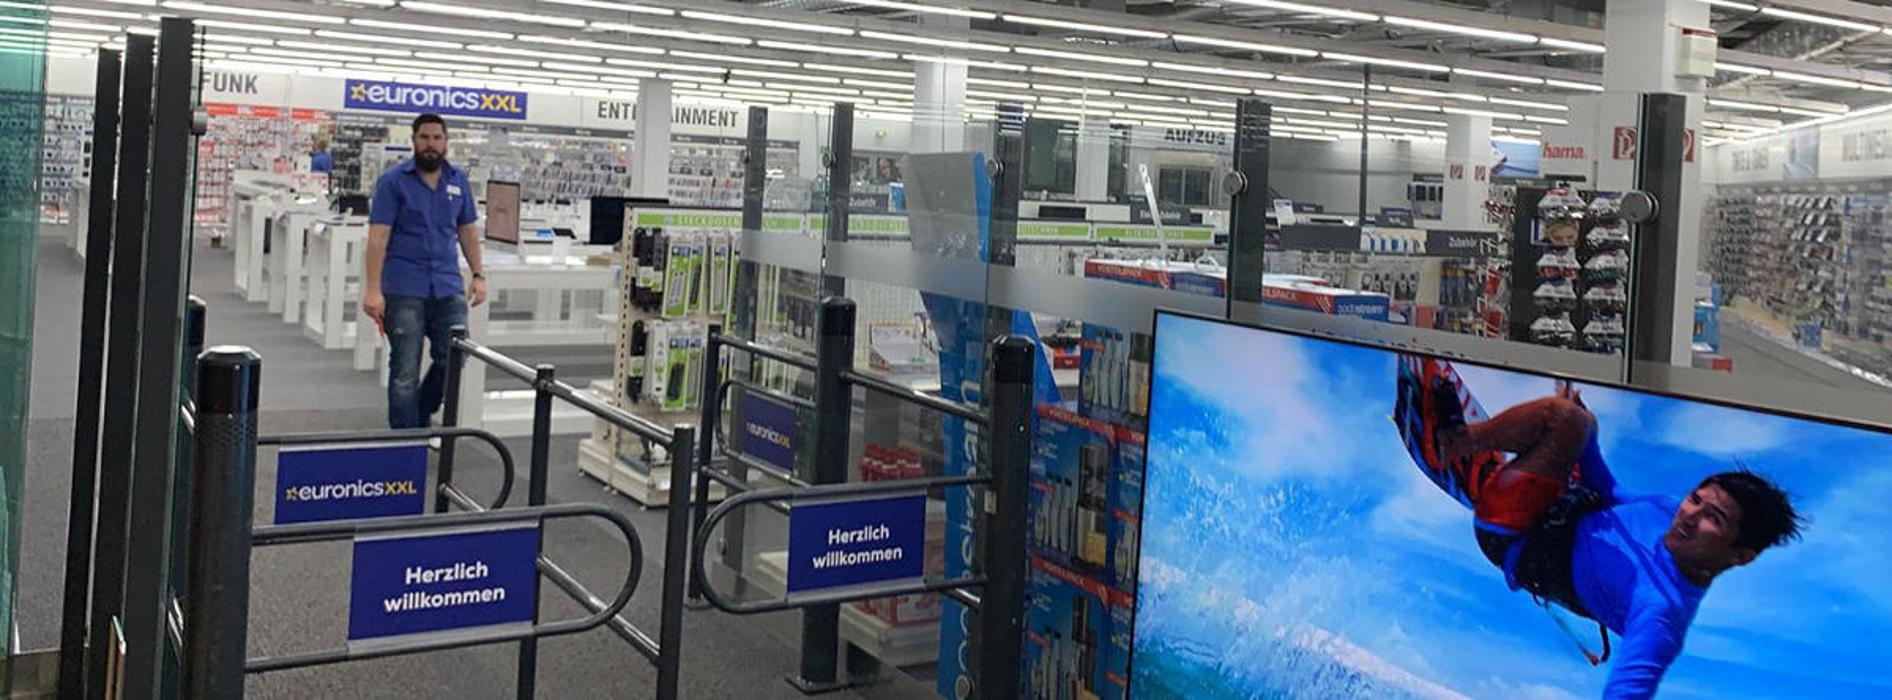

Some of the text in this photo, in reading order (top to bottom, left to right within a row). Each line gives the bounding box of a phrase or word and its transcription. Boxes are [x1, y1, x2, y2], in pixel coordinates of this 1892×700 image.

[1543, 142, 1584, 159] hama
[828, 524, 890, 545] Herzlich
[812, 546, 903, 569] willkommen
[405, 561, 488, 585] Herzlich
[384, 587, 505, 612] willkommen
